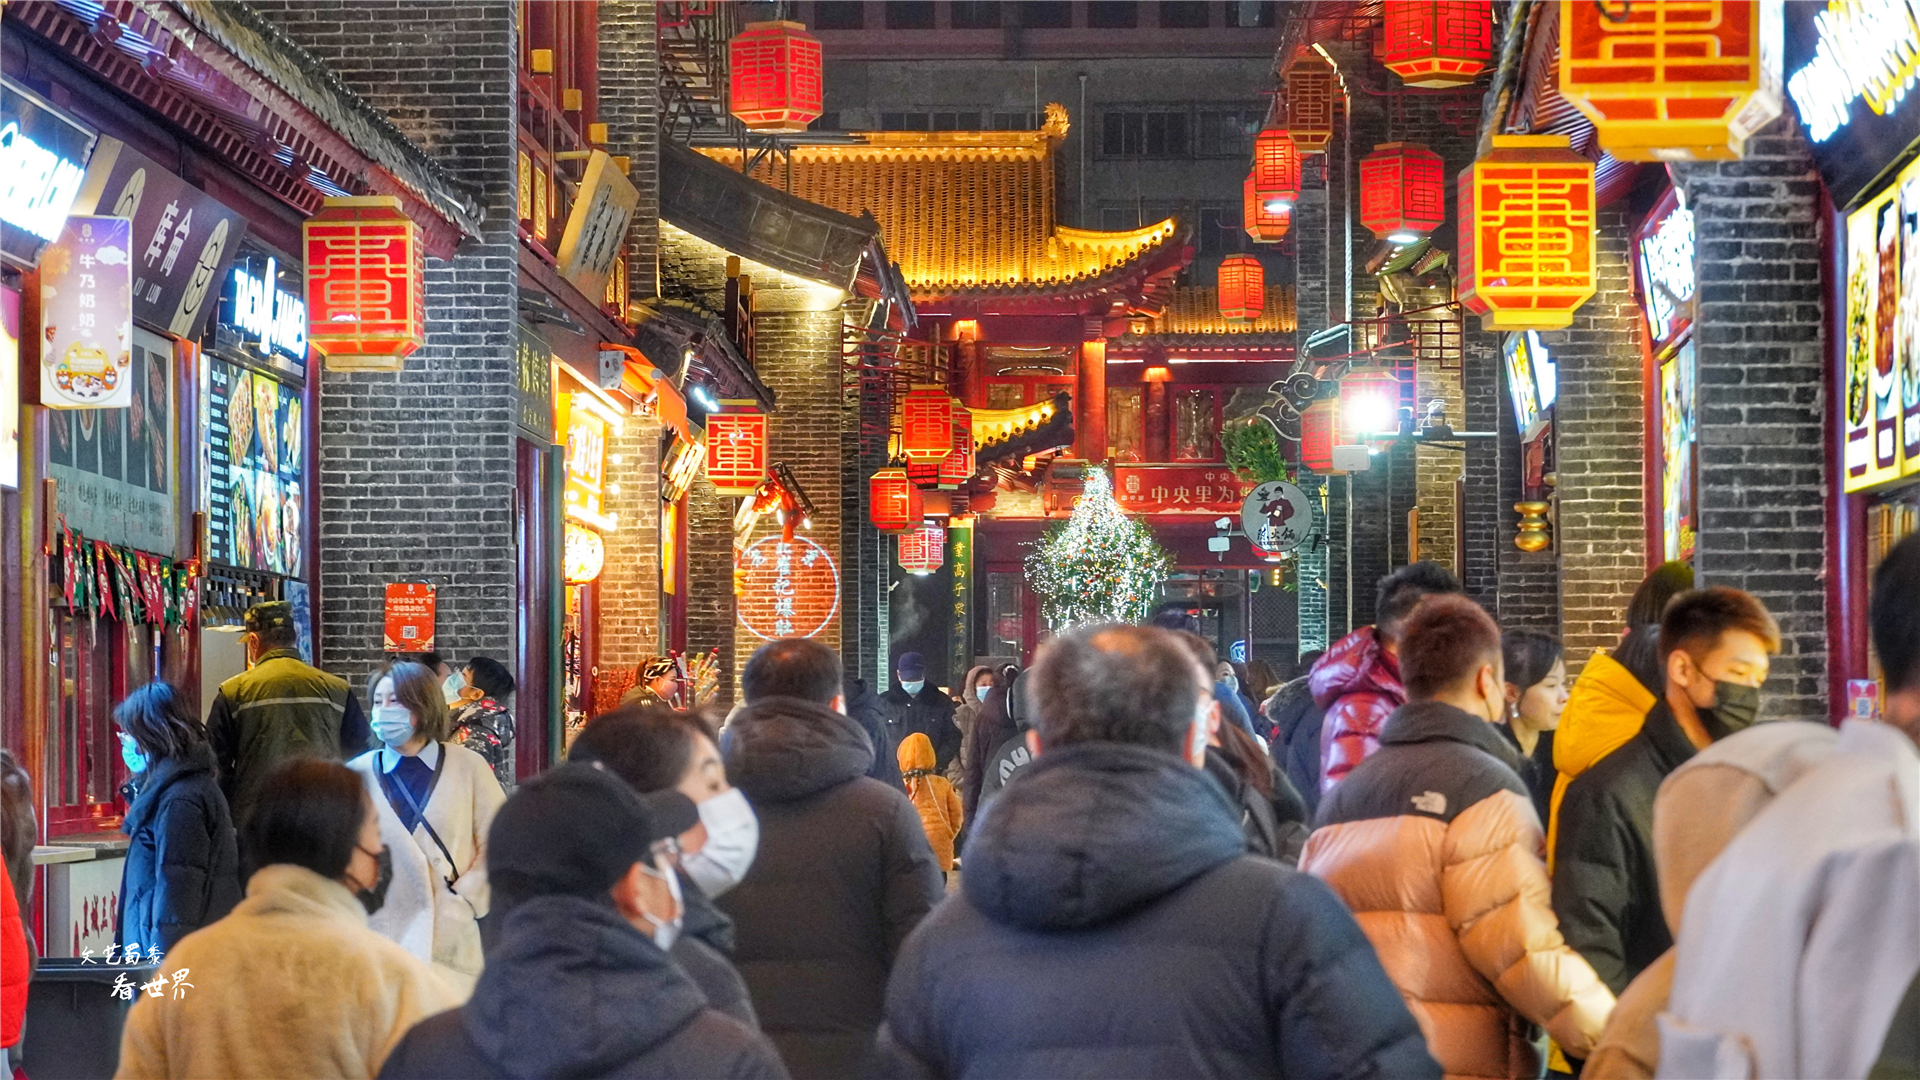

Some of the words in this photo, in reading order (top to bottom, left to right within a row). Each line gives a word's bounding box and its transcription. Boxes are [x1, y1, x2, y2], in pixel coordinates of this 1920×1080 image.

[79, 254, 96, 328] 牛乃奶奶
[1151, 485, 1245, 504] 中央里为
